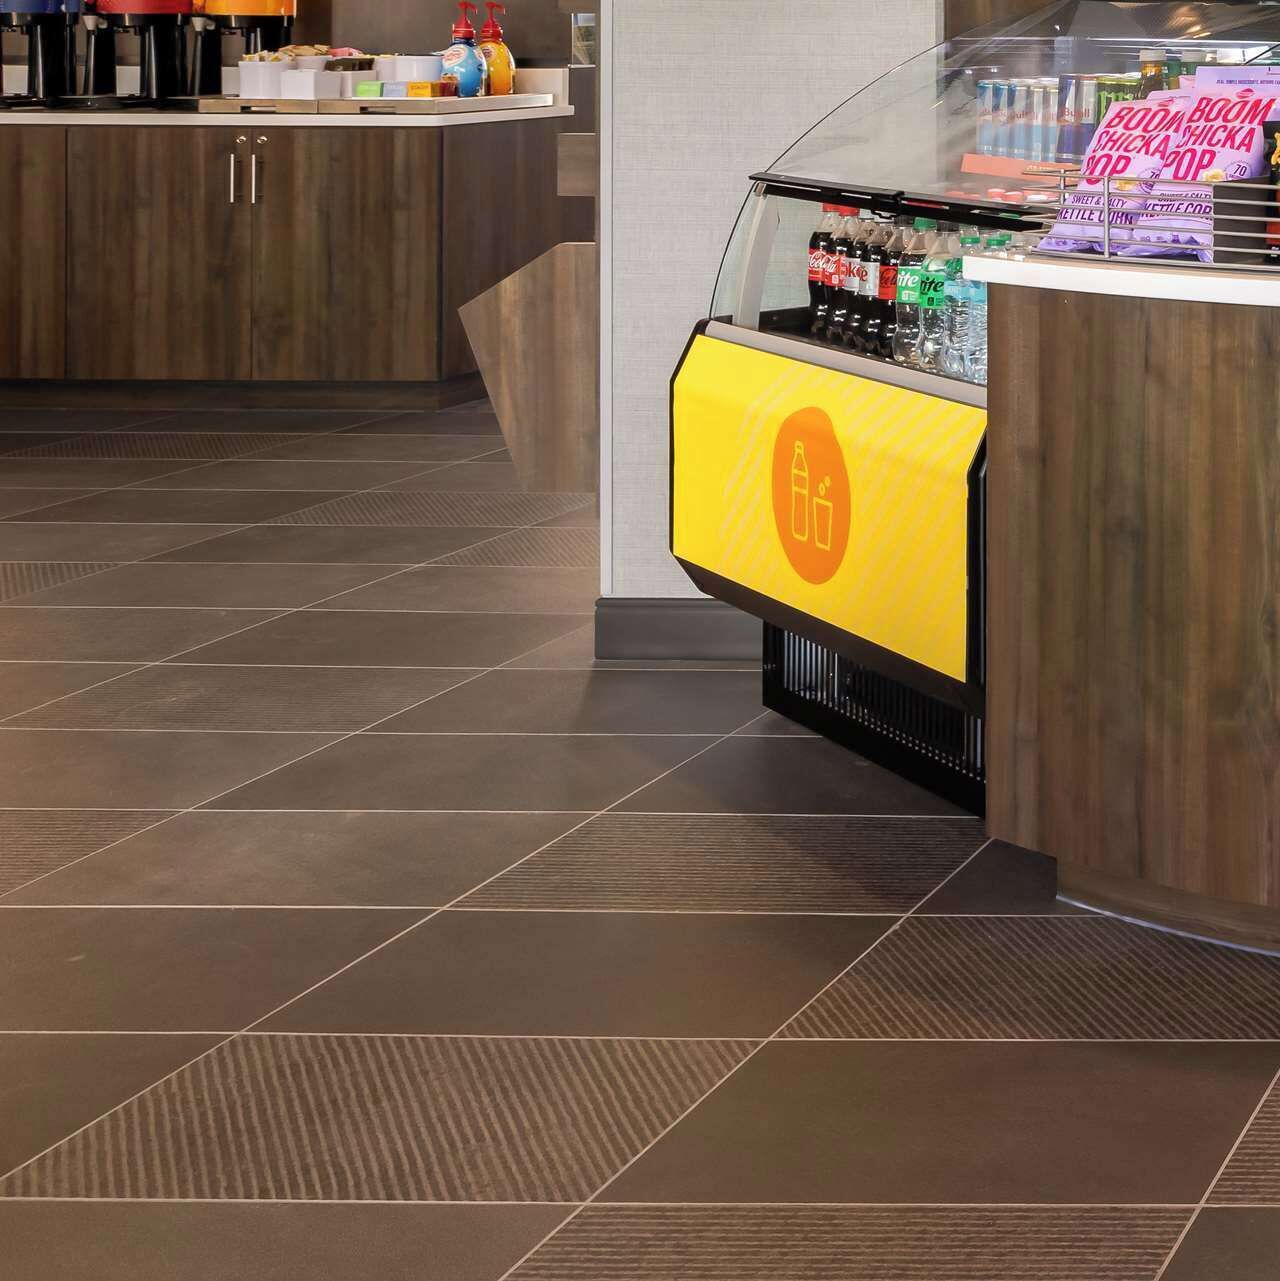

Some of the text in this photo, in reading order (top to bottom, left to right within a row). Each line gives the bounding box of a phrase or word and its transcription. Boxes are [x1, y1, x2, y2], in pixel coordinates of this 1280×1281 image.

[1104, 106, 1186, 135] BOOM
[1189, 96, 1277, 126] BOOM
[1093, 130, 1171, 163] CHICKA
[1176, 125, 1257, 154] CHICKA
[1081, 154, 1132, 185] POP
[1163, 148, 1217, 181] POP
[1233, 163, 1248, 177] 70
[1071, 195, 1094, 204] SWEET
[1184, 203, 1213, 220] COR
